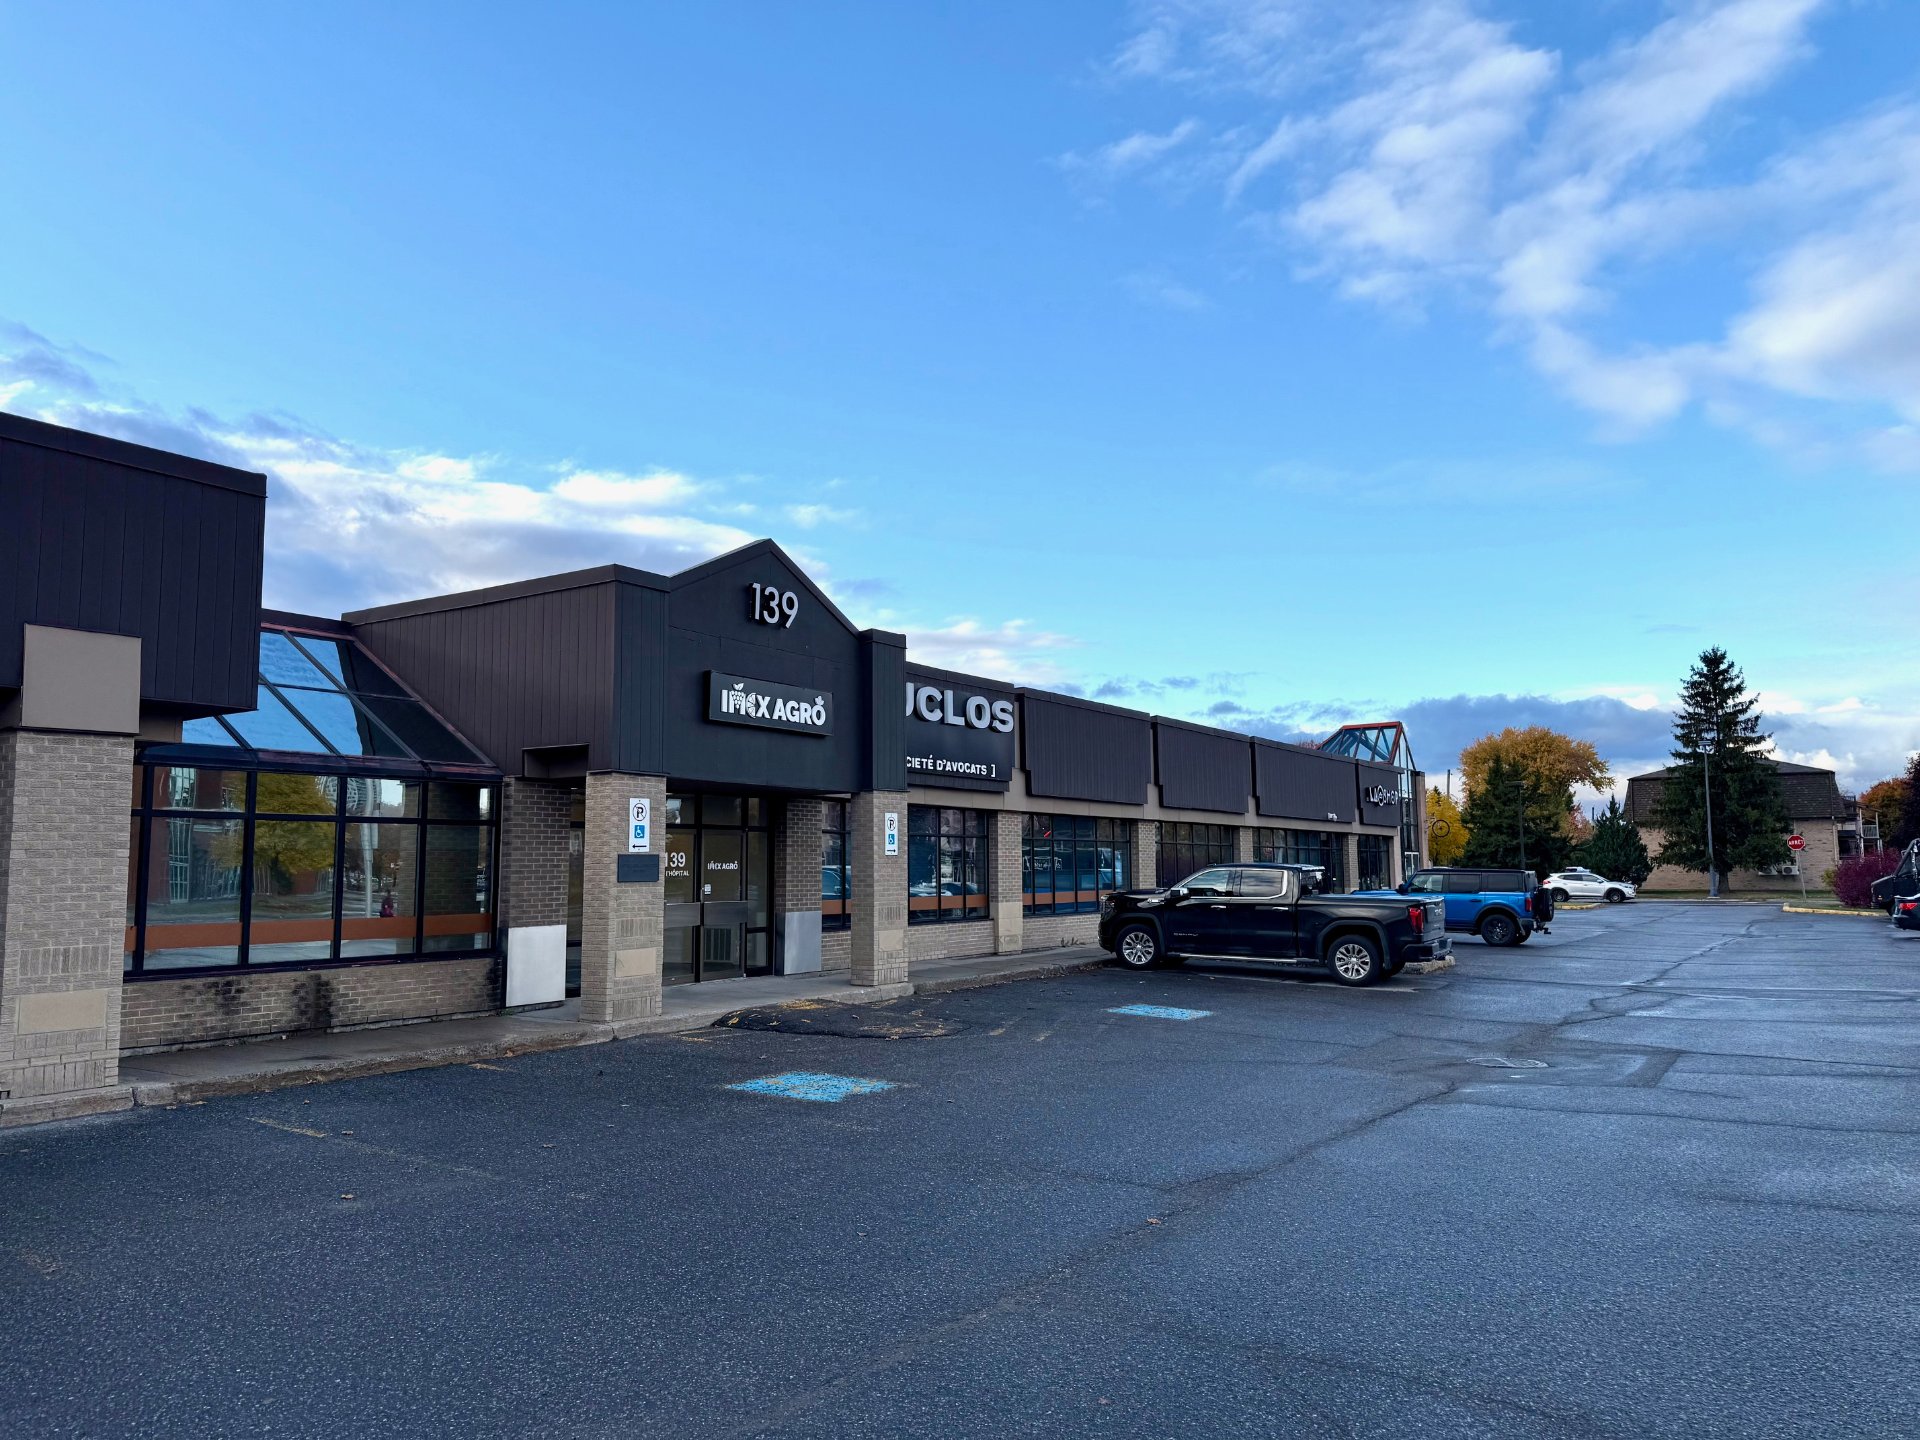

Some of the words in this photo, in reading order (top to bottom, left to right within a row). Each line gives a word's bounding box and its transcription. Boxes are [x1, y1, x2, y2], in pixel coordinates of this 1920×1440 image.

[752, 582, 799, 629] 139
[772, 695, 826, 726] AGRO
[936, 760, 988, 776] D'AVOCATS
